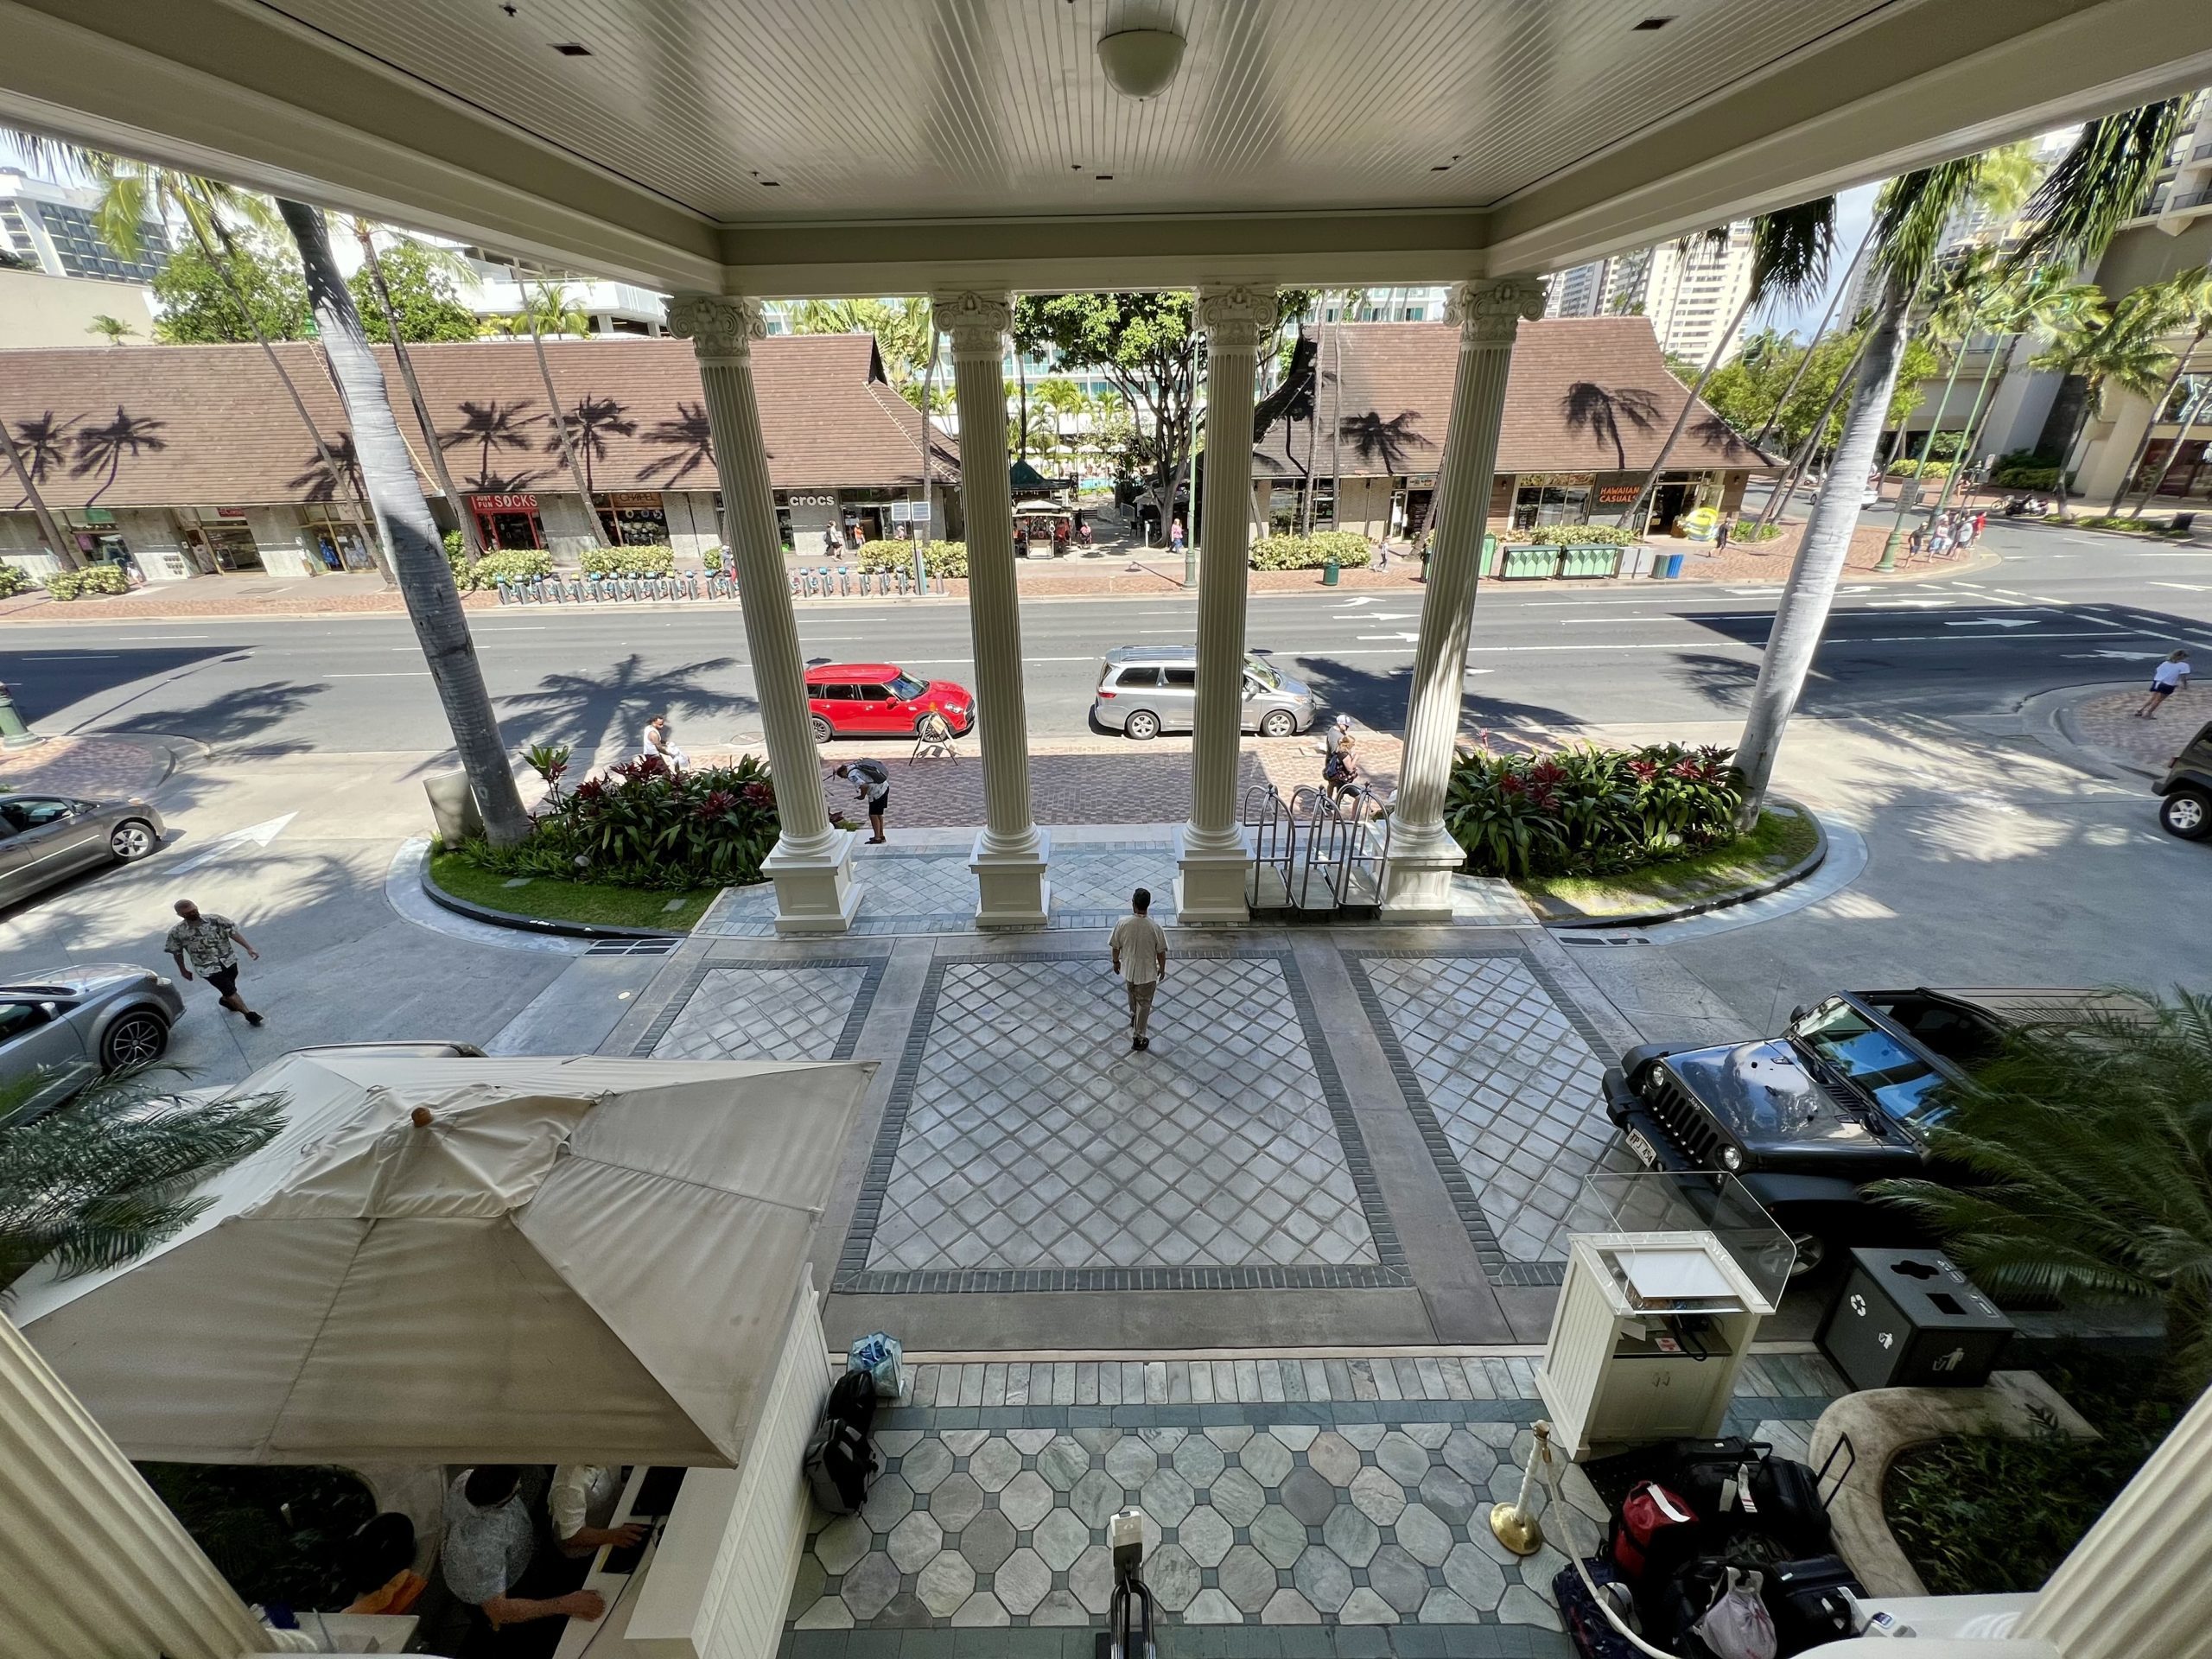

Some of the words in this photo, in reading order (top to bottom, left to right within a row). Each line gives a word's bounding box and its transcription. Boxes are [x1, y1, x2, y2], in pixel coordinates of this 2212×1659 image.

[1600, 486, 1640, 494] HAWAIIAN
[494, 494, 537, 507] SOCKS
[789, 495, 835, 506] crocs
